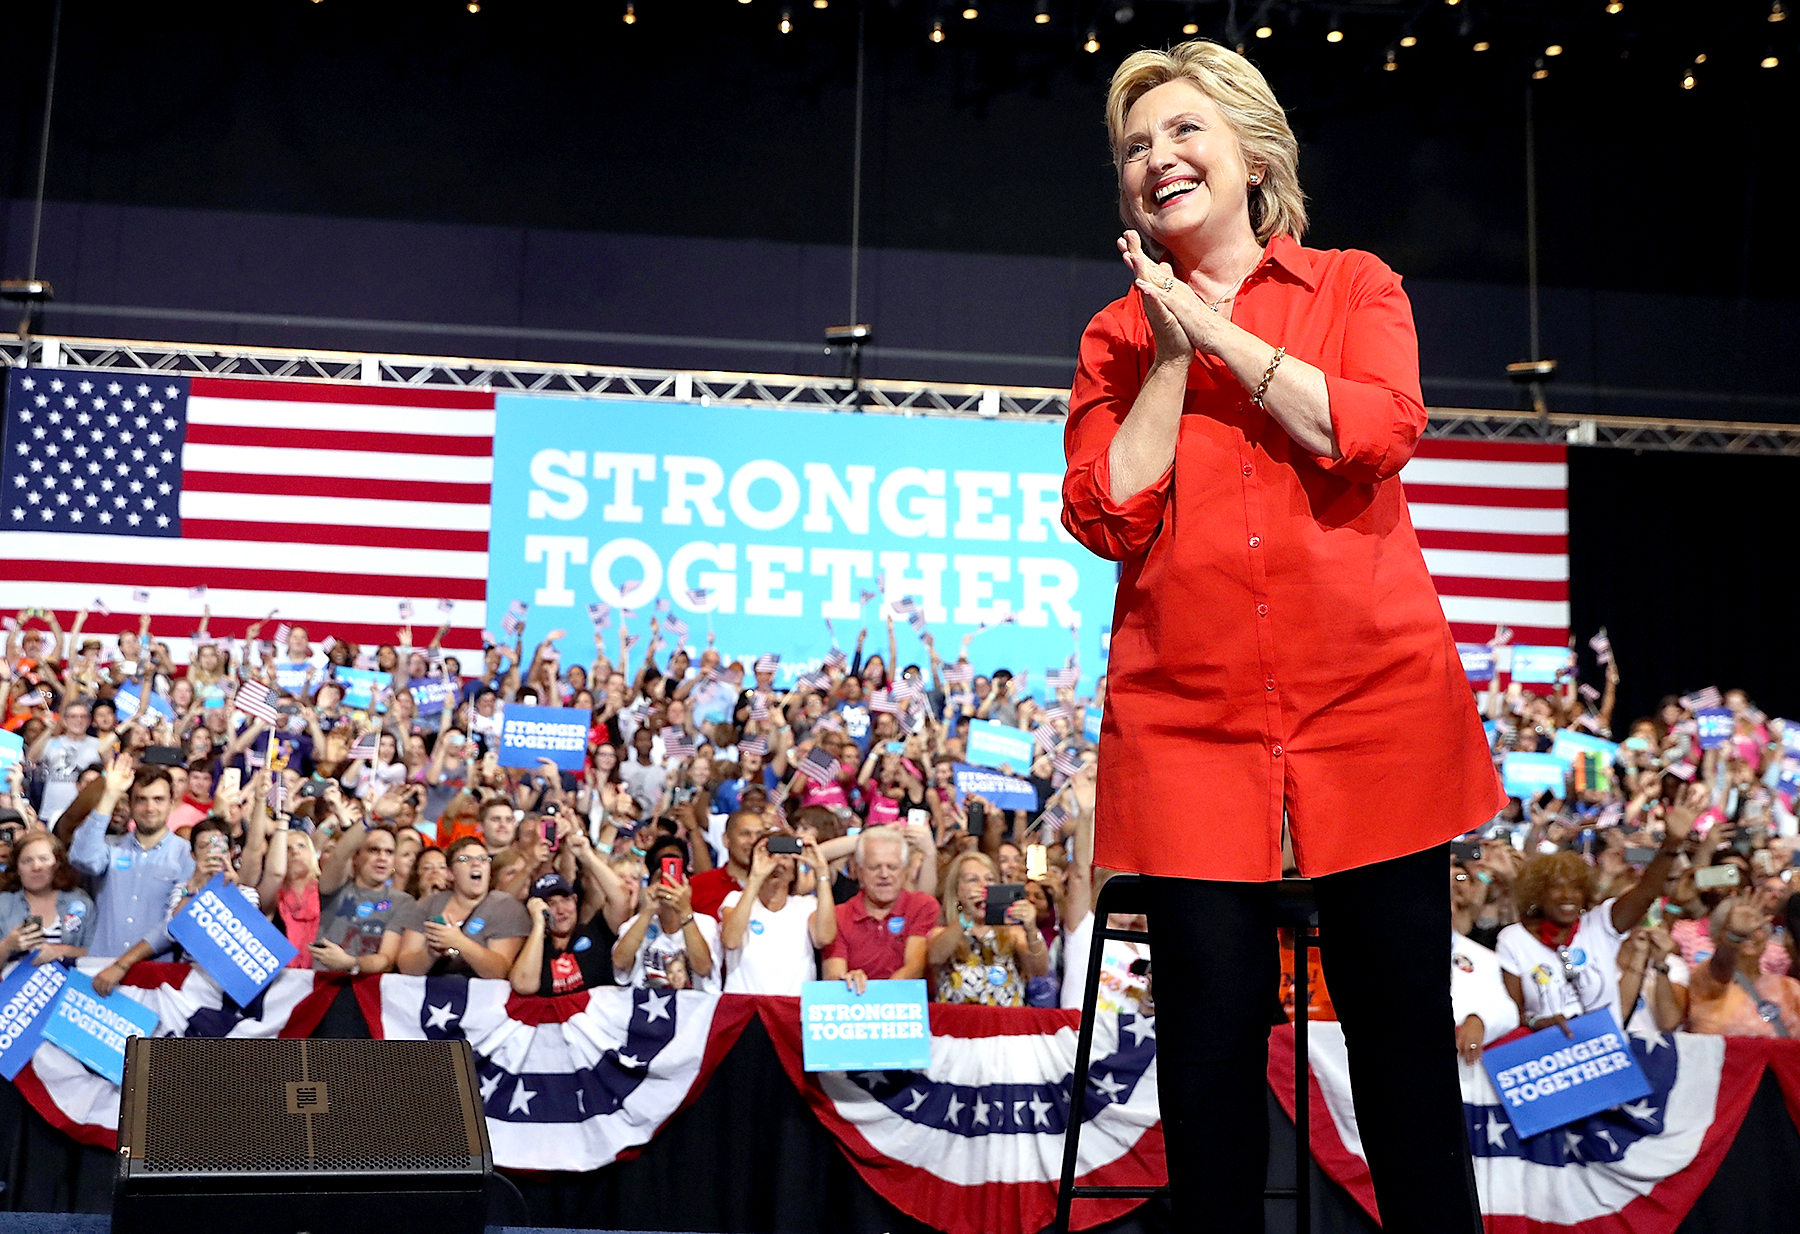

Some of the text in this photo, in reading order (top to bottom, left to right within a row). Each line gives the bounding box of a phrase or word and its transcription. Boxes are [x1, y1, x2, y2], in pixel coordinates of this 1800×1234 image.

[528, 449, 1076, 543] STRONGER
[525, 535, 1082, 627] TOGETHER
[503, 733, 585, 751] TOGETHER
[504, 720, 587, 738] STRONGER
[188, 901, 268, 985] TOGETHER
[199, 890, 280, 974] STRONGER
[0, 963, 57, 1031] RONGER
[0, 972, 67, 1058] OGETHER
[808, 1003, 923, 1022] STRONGER
[58, 1001, 126, 1054] TOGETHE
[808, 1022, 924, 1041] TOGETHER
[1496, 1033, 1622, 1089] STRONGER
[1504, 1051, 1632, 1106] TOGETHER
